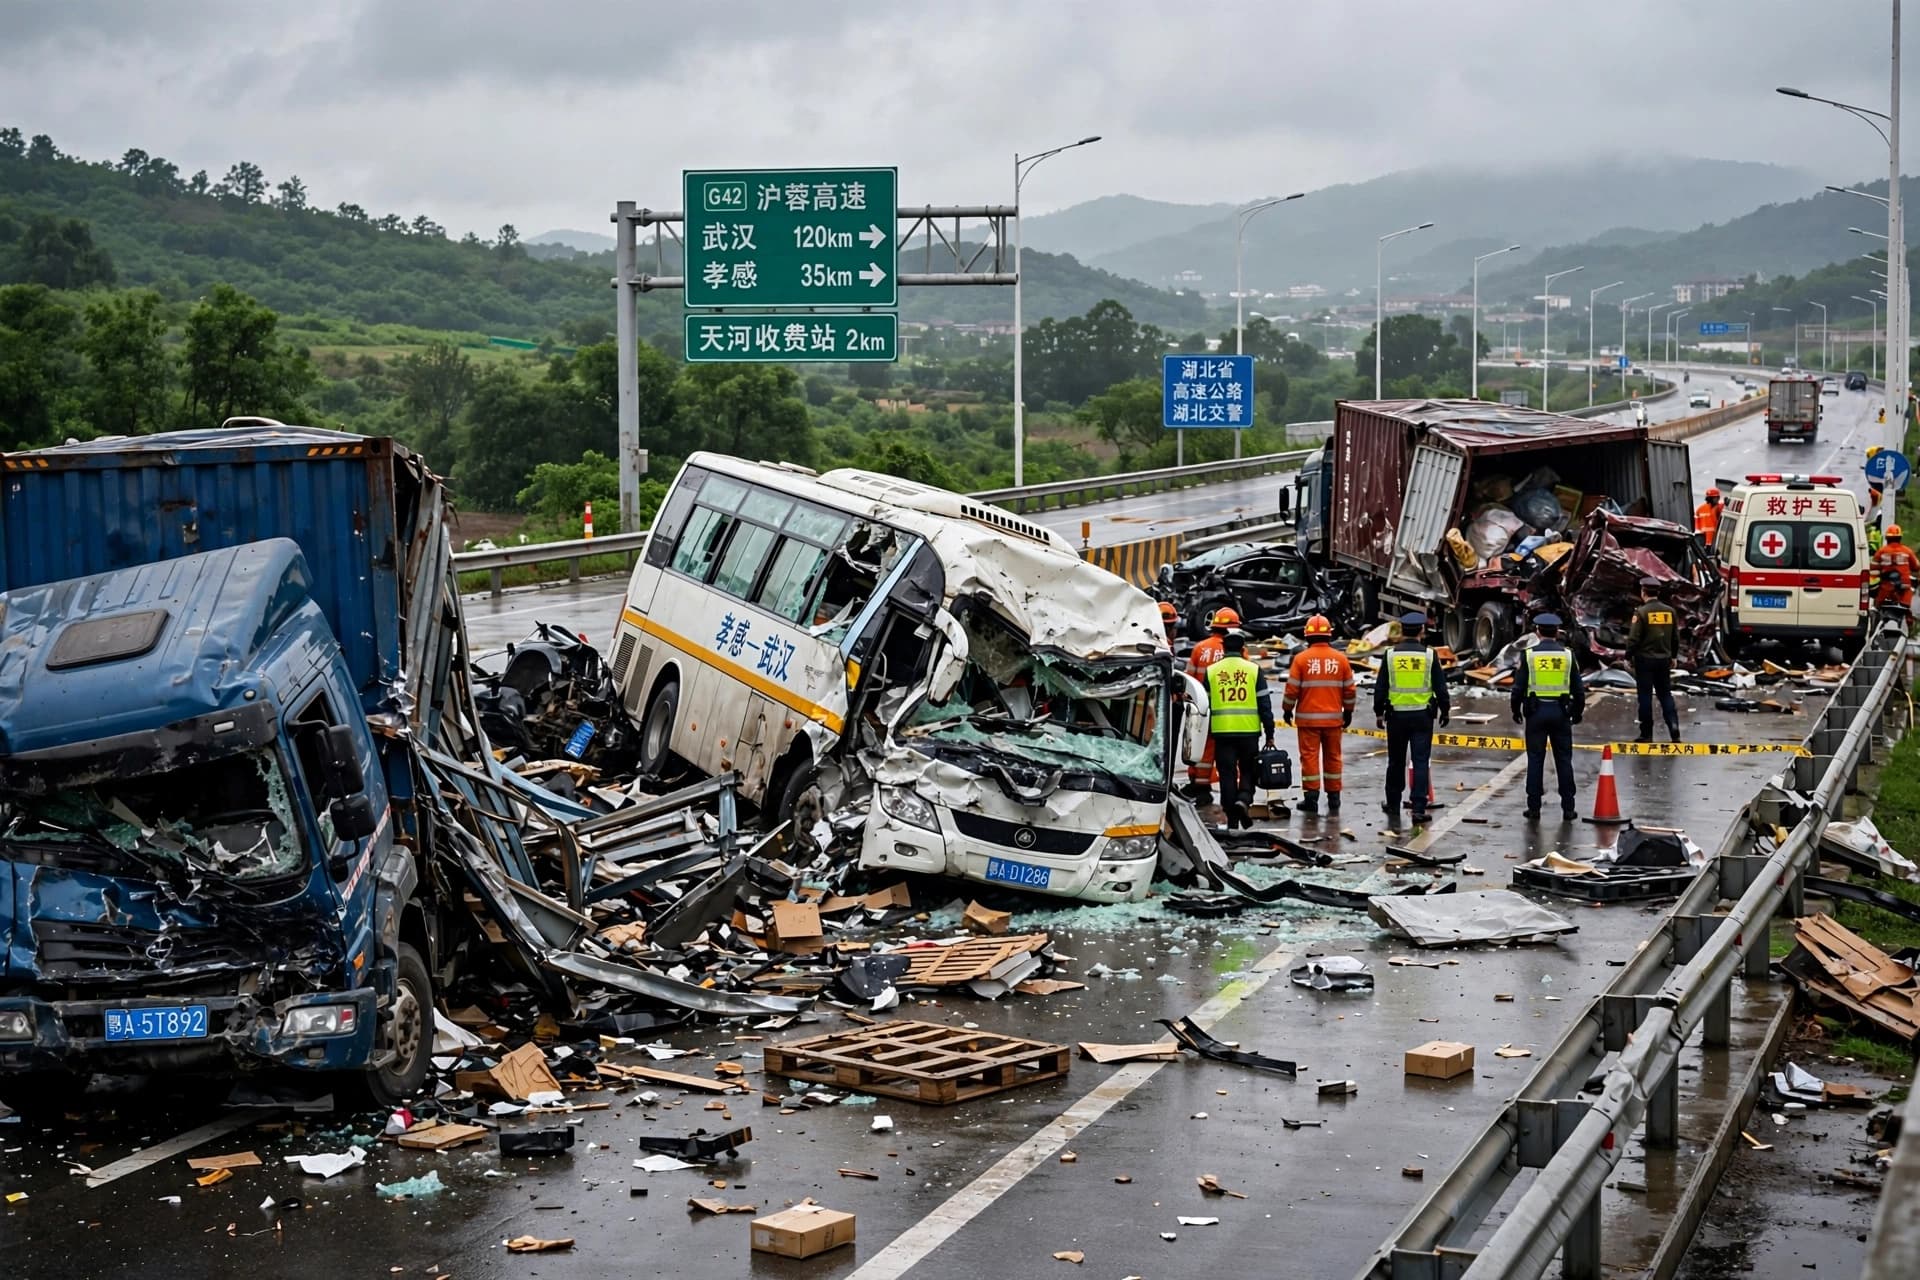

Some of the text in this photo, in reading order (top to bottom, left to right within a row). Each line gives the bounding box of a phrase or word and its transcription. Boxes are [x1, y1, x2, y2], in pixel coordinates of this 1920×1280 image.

[708, 181, 867, 212] G42 沪蓉高速
[702, 221, 853, 251] 武汉 120km
[702, 260, 852, 290] 孝感 35km
[699, 323, 885, 352] 天河收费站 2km
[1181, 360, 1235, 379] 湖北省
[1173, 403, 1243, 422] 湖北交警
[1766, 495, 1837, 517] 救护车
[1307, 658, 1339, 675] 消防
[1219, 687, 1247, 702] 120
